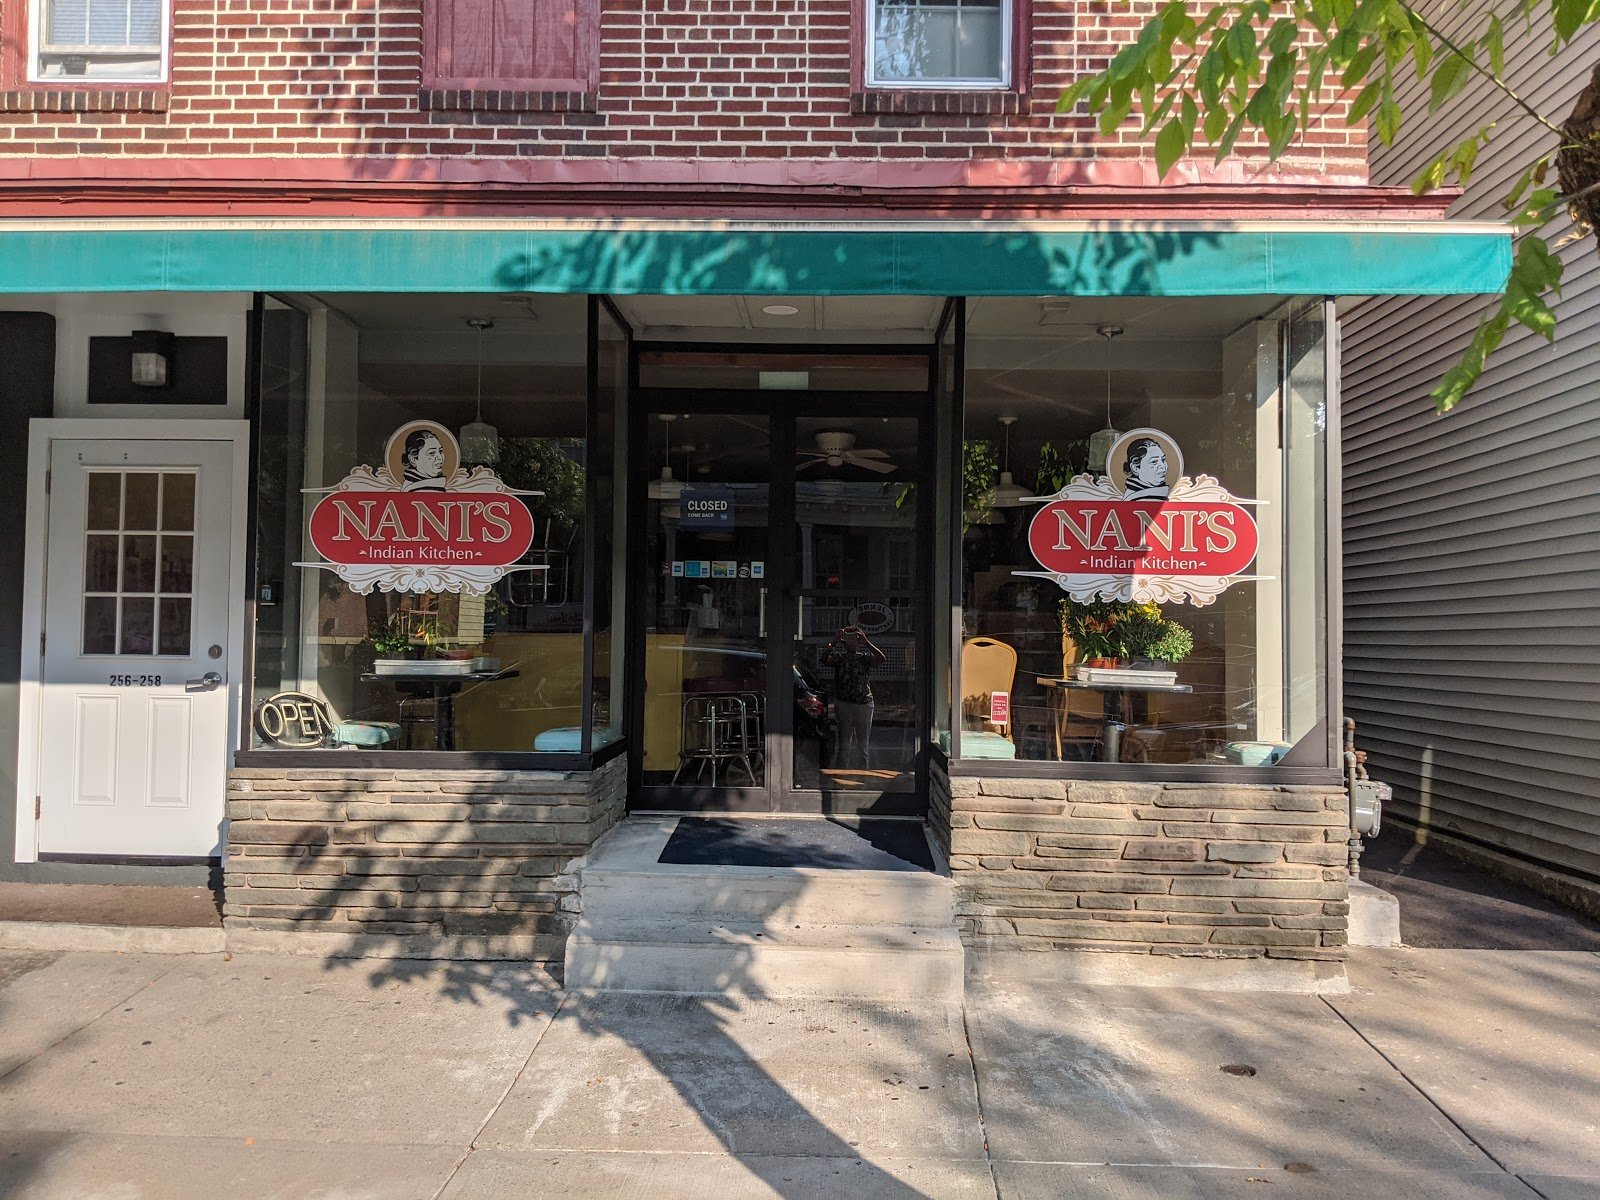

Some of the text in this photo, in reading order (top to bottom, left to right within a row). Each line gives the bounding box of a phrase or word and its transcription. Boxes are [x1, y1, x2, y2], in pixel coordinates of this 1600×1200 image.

[687, 500, 728, 511] CLOSED
[331, 499, 513, 543] NANI'S
[1051, 508, 1238, 554] NANI'S
[369, 545, 474, 560] Indian Kitchen
[1090, 555, 1198, 570] Indian Kitchen
[110, 674, 162, 687] 256-258
[260, 702, 335, 737] OPEN
